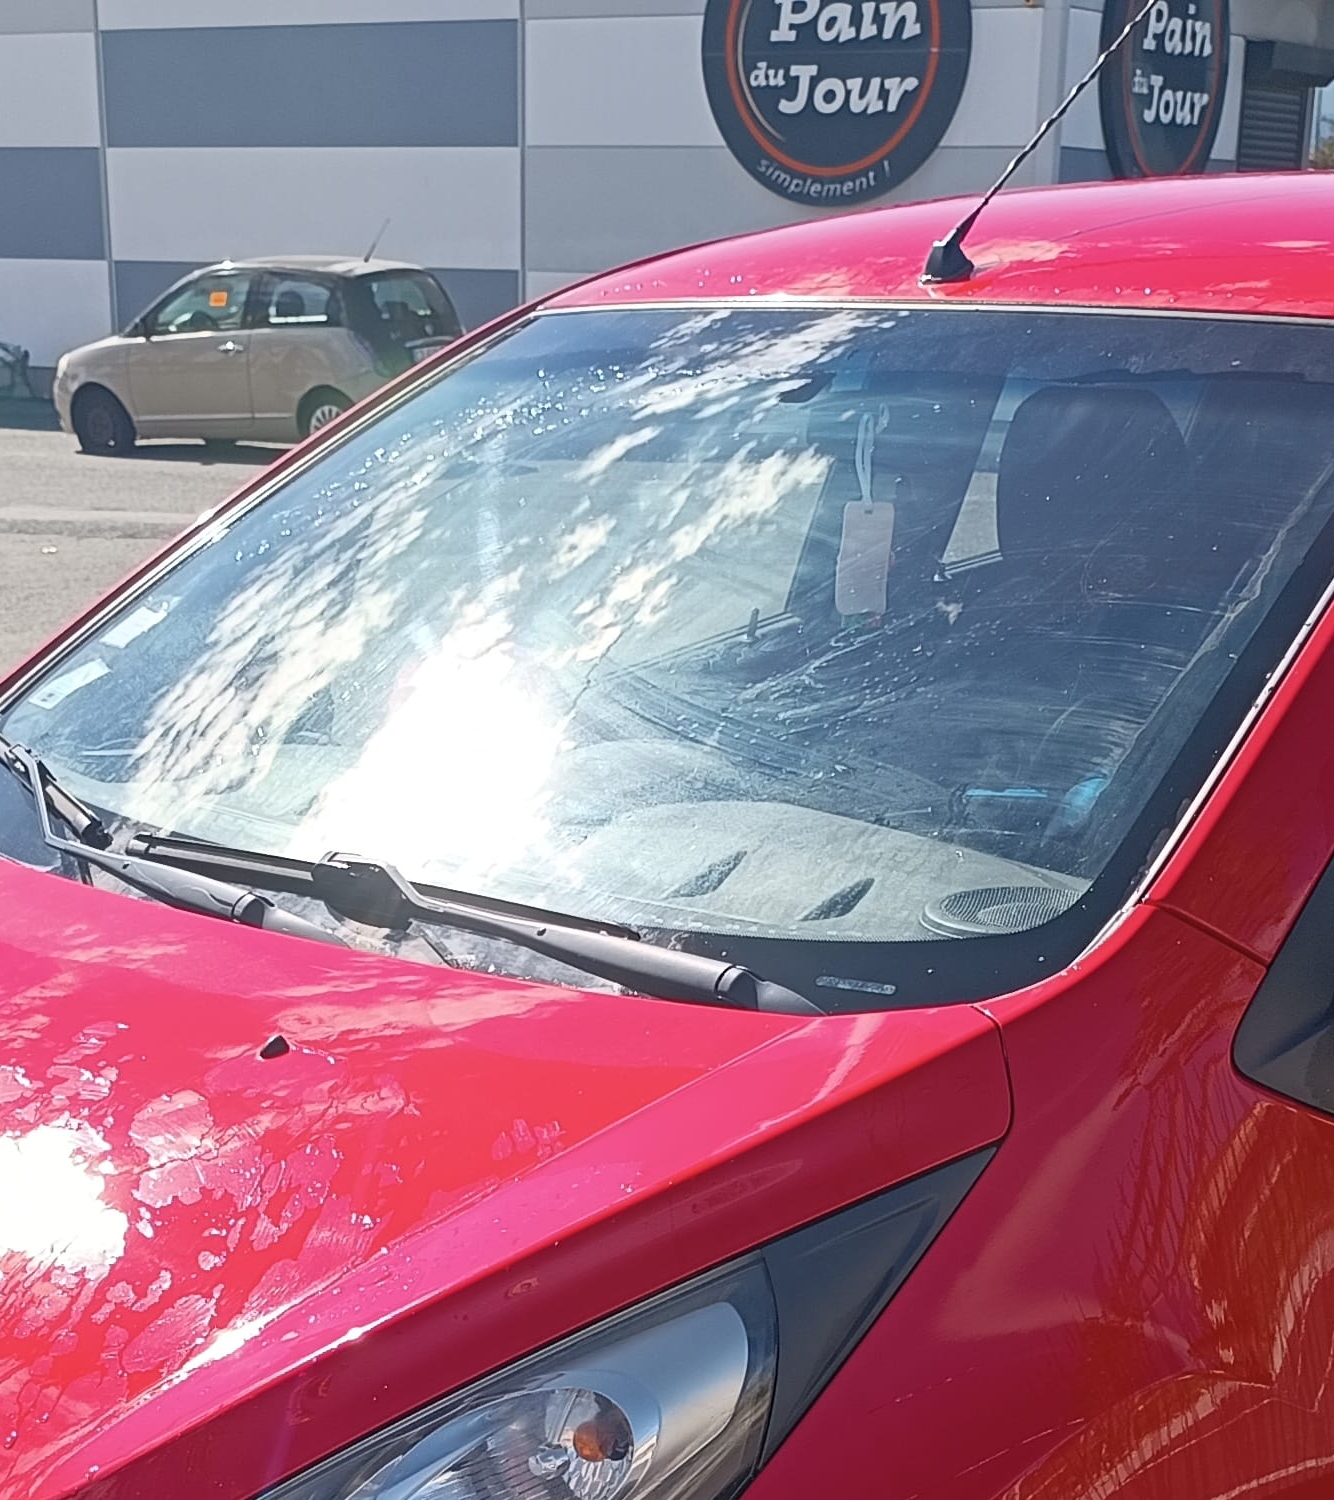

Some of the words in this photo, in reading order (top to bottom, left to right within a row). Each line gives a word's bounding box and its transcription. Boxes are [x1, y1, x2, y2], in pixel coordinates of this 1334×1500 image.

[769, 0, 922, 43] Pain
[1142, 0, 1212, 57] Pain
[749, 61, 786, 88] du
[778, 64, 919, 115] Jour
[1143, 74, 1210, 126] Jour
[756, 159, 876, 198] simplement
